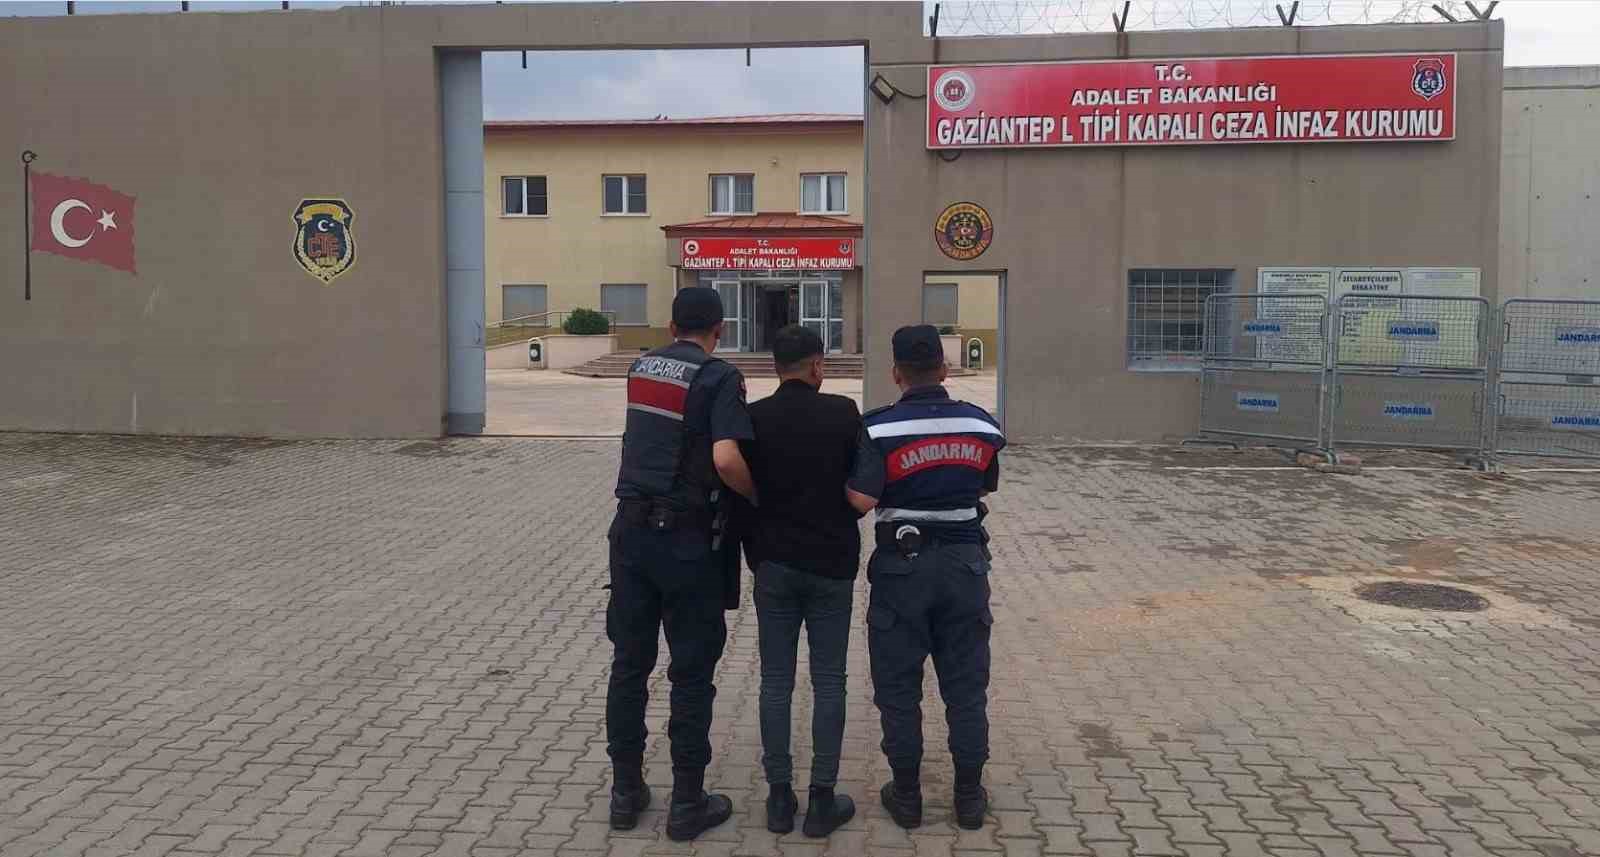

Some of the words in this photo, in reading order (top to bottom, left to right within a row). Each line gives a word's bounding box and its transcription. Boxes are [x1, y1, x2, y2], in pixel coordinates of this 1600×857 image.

[1155, 64, 1192, 81] T.C.
[1071, 88, 1152, 106] ADALET
[1159, 83, 1276, 104] BAKANLIĞI
[937, 112, 1055, 145] GAZİANTEP
[1061, 117, 1073, 142] L
[1080, 110, 1121, 142] TİPİ
[1128, 113, 1204, 142] KAPALI
[1211, 111, 1269, 140] CEZA
[1275, 106, 1339, 138] İNFAZ
[1345, 109, 1443, 138] KURUMU
[726, 256, 731, 268] L
[749, 257, 775, 268] KAPALI
[776, 257, 796, 268] CEZA
[820, 257, 852, 268] KURUMU
[901, 443, 984, 470] JANDARMA
